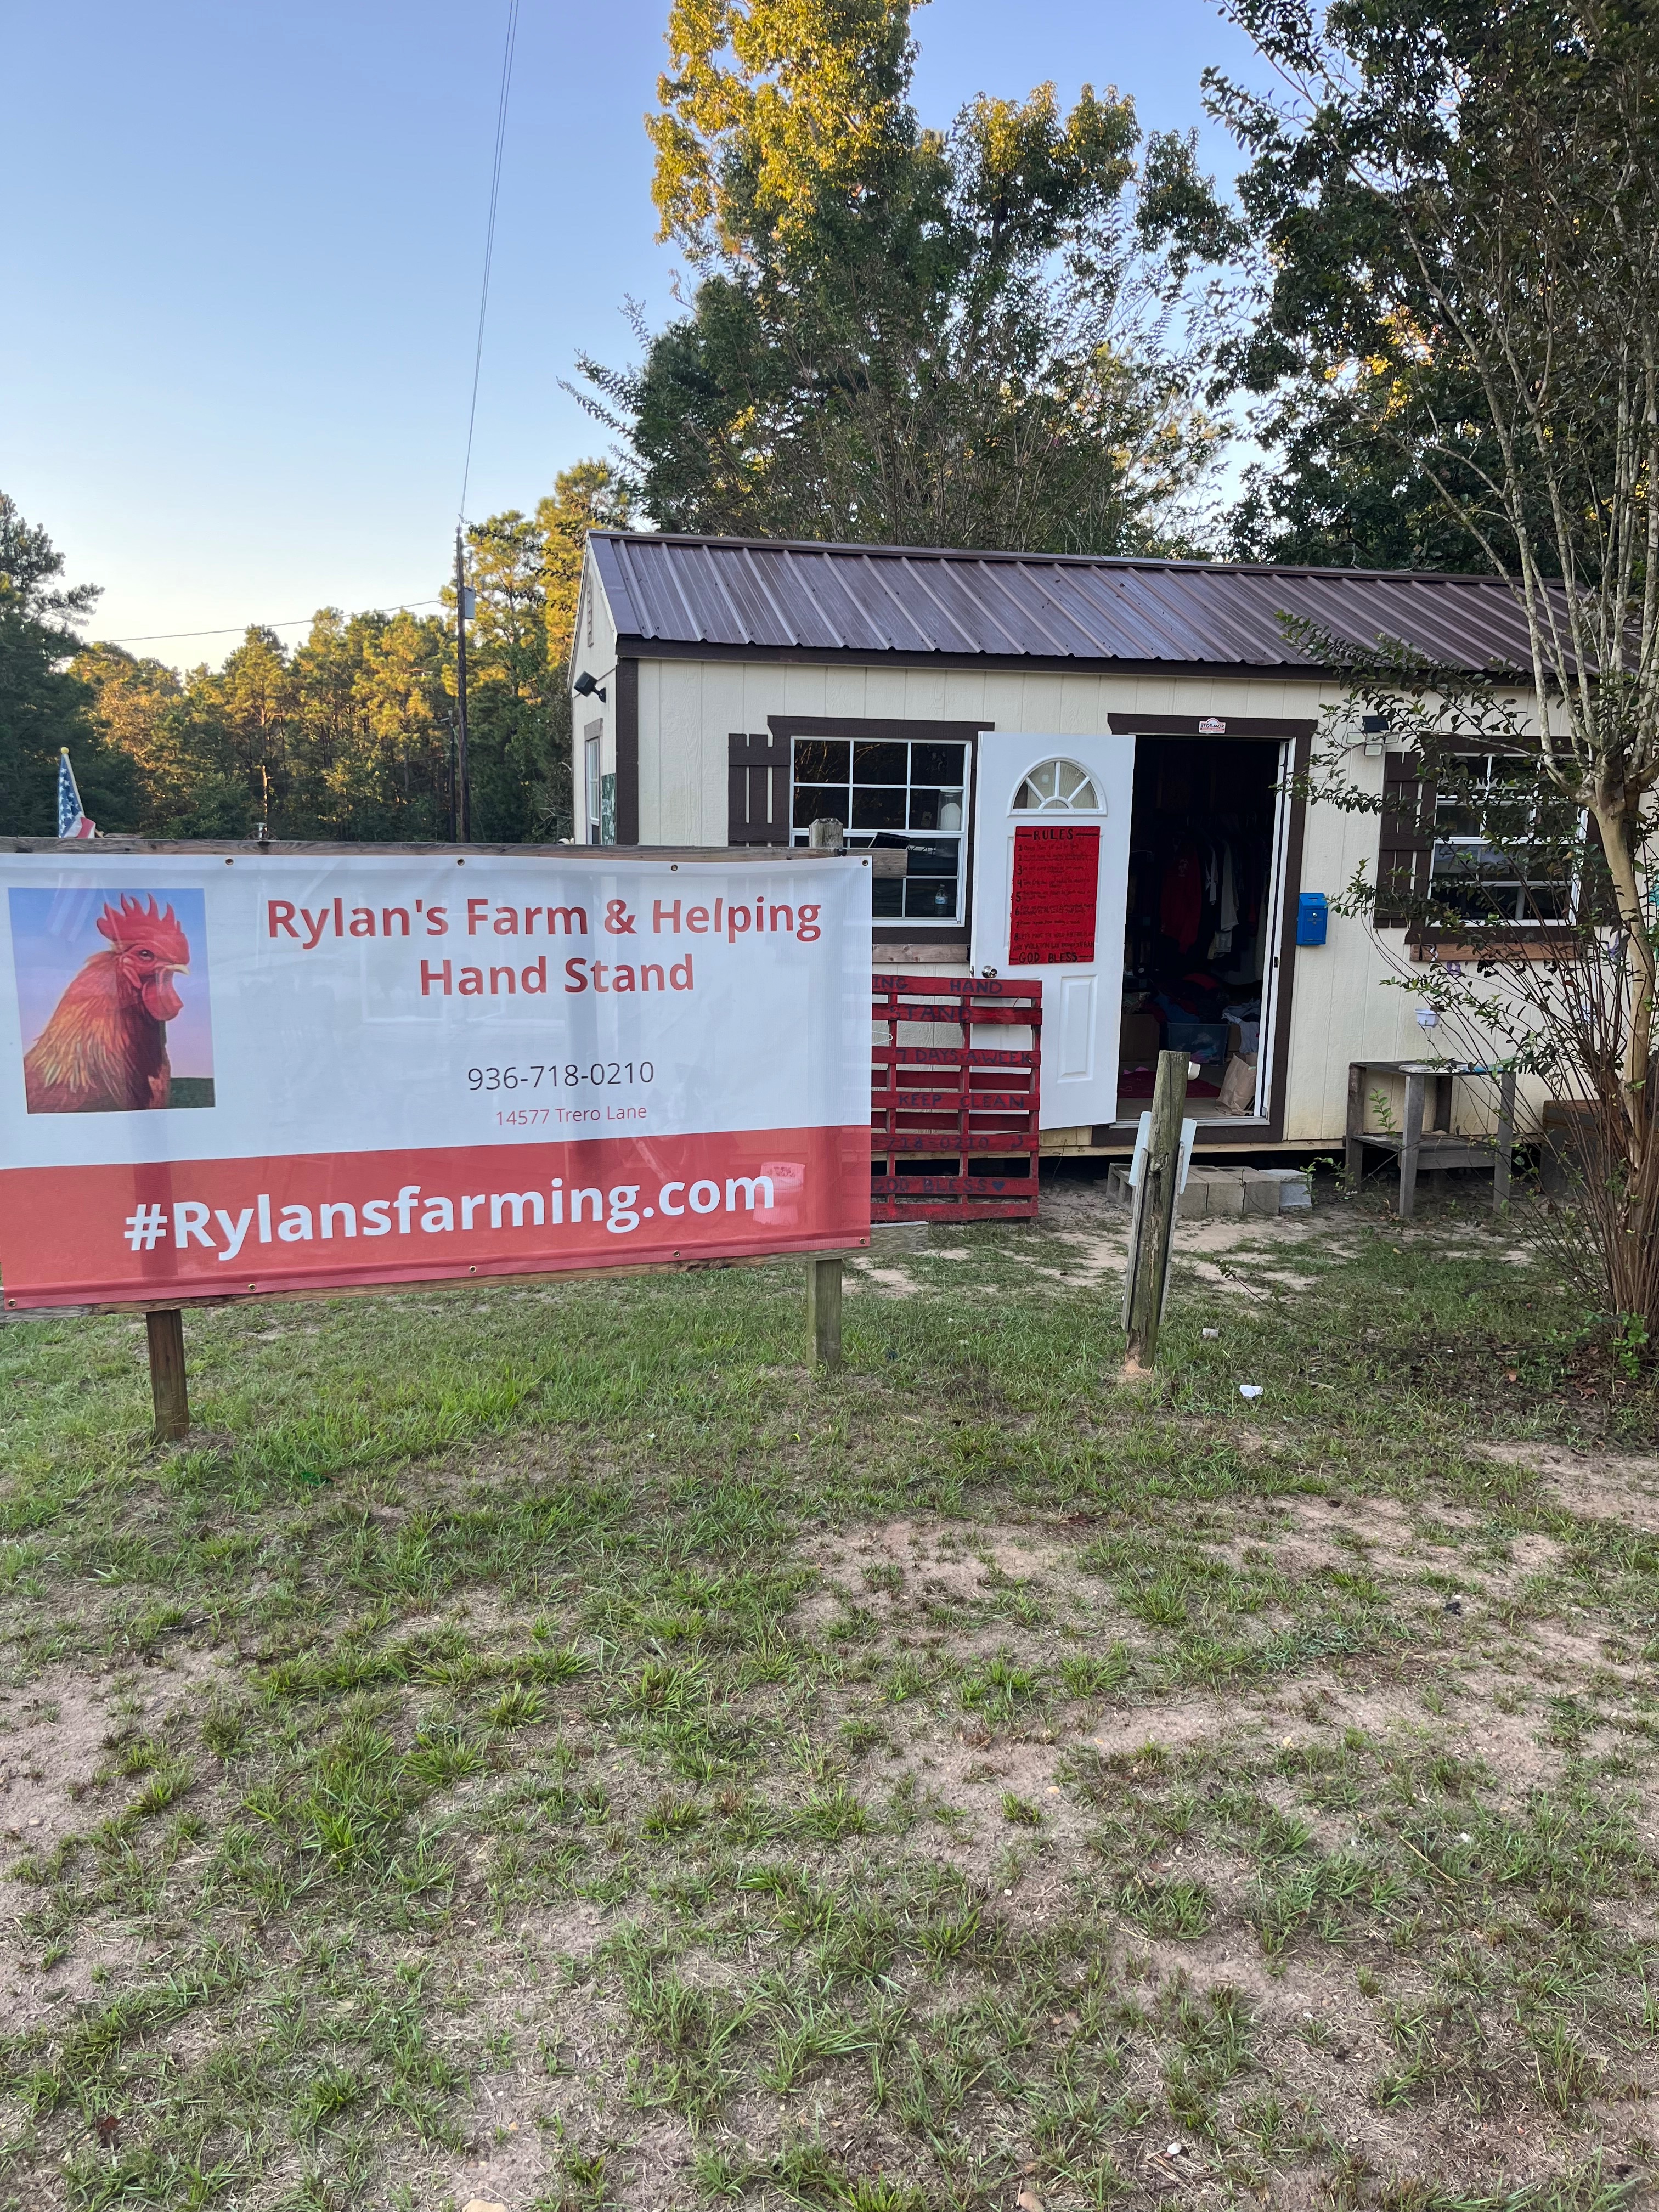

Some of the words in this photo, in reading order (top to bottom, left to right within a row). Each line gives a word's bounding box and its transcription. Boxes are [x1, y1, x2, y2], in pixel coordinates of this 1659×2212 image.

[1034, 828, 1074, 840] RULES
[1018, 865, 1023, 876] 3
[1017, 879, 1022, 888] 4
[1016, 891, 1022, 902] 5
[1015, 906, 1020, 916] 6
[268, 898, 449, 950] Rylan's
[467, 899, 588, 935] Farm
[604, 899, 637, 934] &
[653, 896, 821, 944] Helping
[1019, 952, 1040, 963] GOD
[1048, 951, 1077, 963] BLESS
[421, 956, 548, 996] Hand
[565, 953, 694, 993] Stand
[872, 976, 909, 989] ING
[950, 980, 1003, 994] HAND
[890, 1005, 972, 1021] STAND
[896, 1049, 907, 1063] 7
[915, 1049, 958, 1063] DAYS
[981, 1052, 1031, 1065] WEEK
[468, 1062, 654, 1091] 936-718-0210
[899, 1093, 943, 1107] KEEP
[960, 1095, 1025, 1109] CLEAN
[496, 1109, 550, 1125] 14577
[555, 1108, 601, 1123] Trero
[607, 1105, 647, 1120] Lane
[872, 1136, 989, 1149] -718-0210
[871, 1178, 909, 1192] GOD
[923, 1178, 987, 1193] BLESS
[124, 1175, 775, 1261] #Rylansfarming.com
